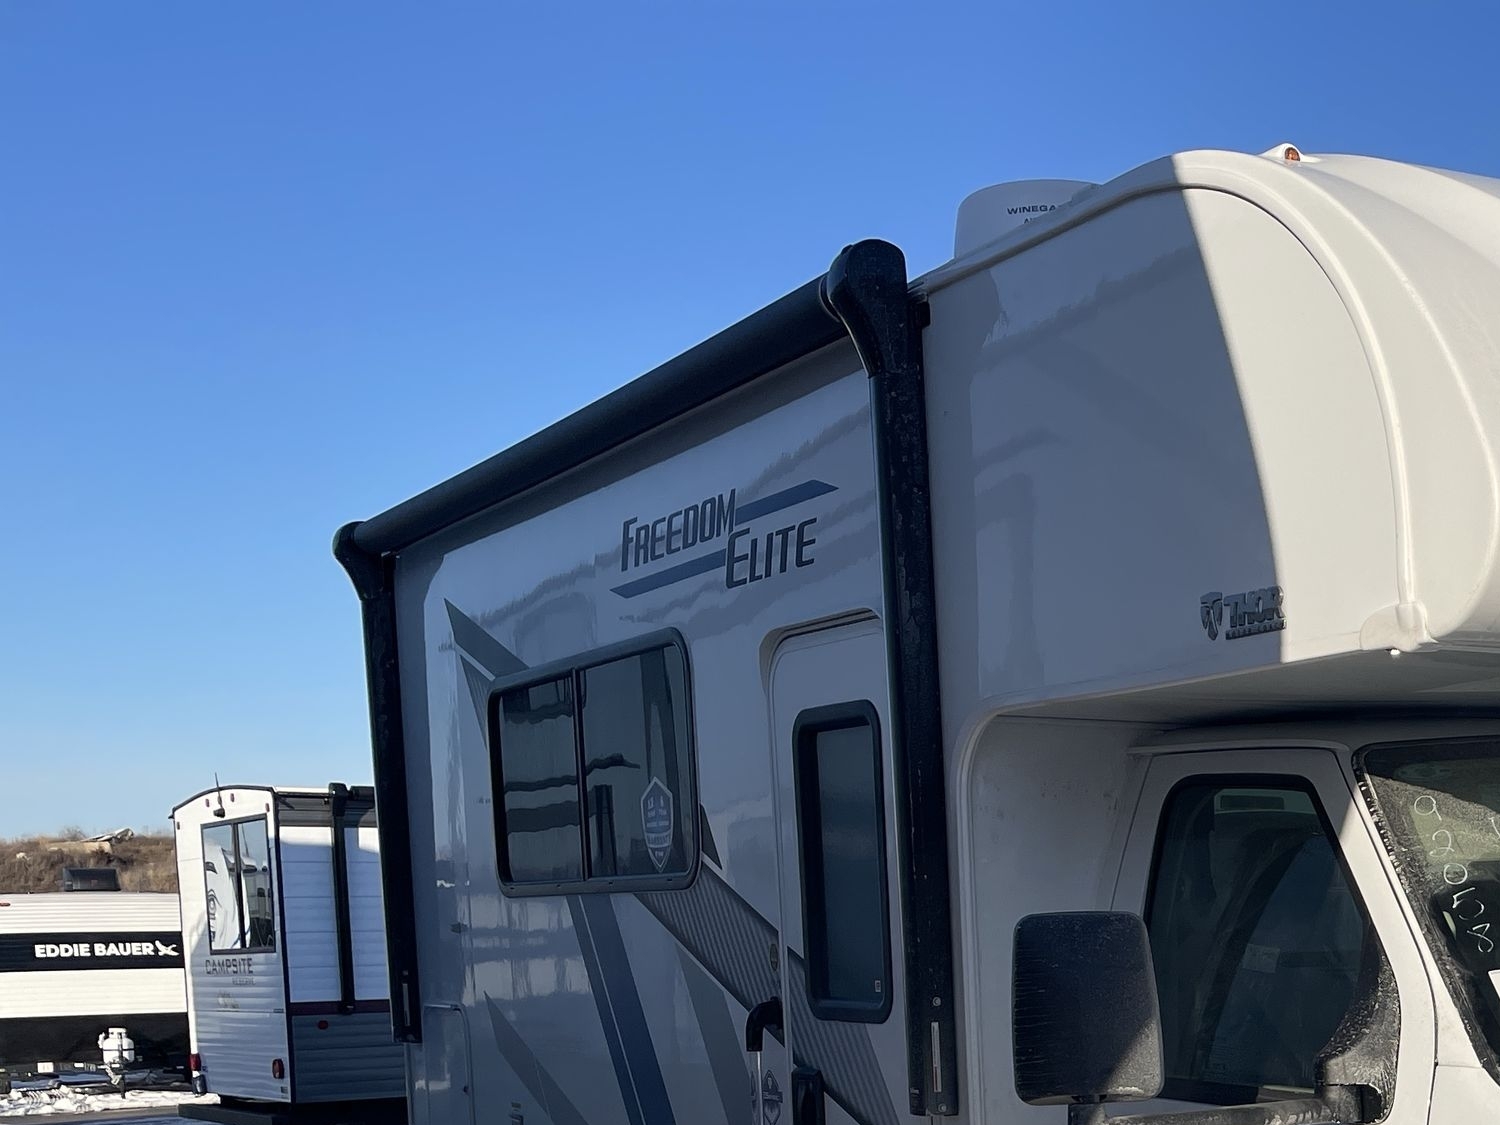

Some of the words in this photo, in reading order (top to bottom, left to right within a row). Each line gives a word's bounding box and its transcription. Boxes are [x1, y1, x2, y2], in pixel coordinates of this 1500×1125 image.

[1006, 204, 1057, 215] WINEGA
[621, 488, 736, 572] FREEDOM
[725, 517, 818, 590] ELITE
[35, 943, 91, 958] EDDIE
[94, 941, 155, 957] BAUER
[205, 957, 254, 975] CAMPSITE
